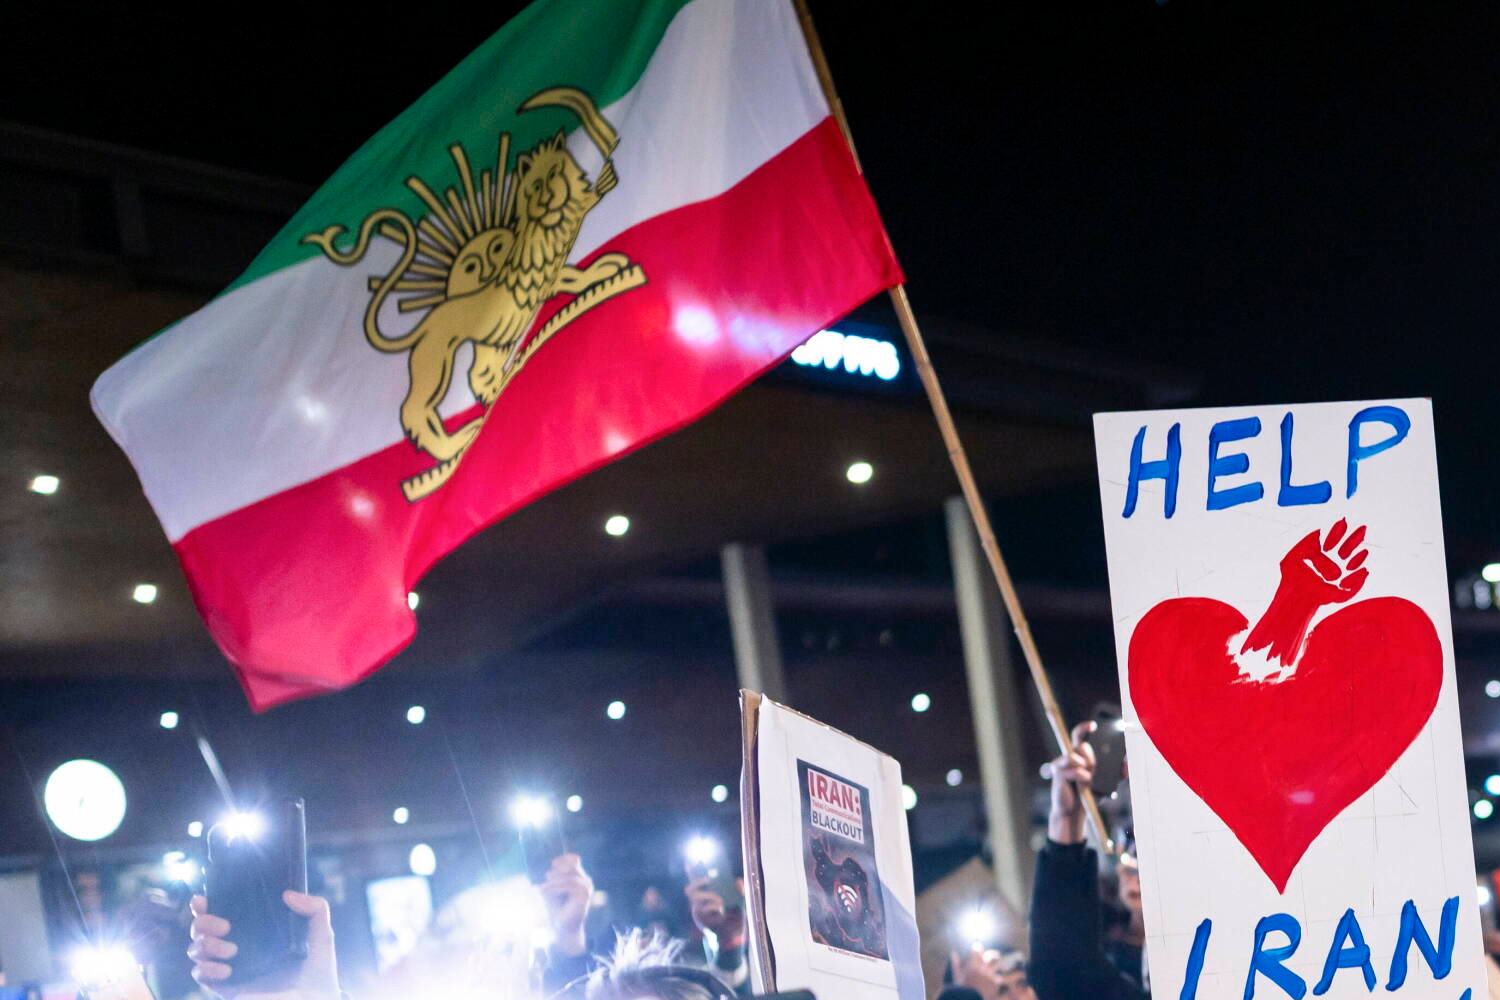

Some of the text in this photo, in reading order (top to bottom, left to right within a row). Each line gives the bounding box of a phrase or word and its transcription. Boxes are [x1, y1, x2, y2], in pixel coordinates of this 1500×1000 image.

[1122, 405, 1411, 519] HELP
[809, 771, 861, 815] IRAN:
[812, 810, 862, 841] BLACKOUT
